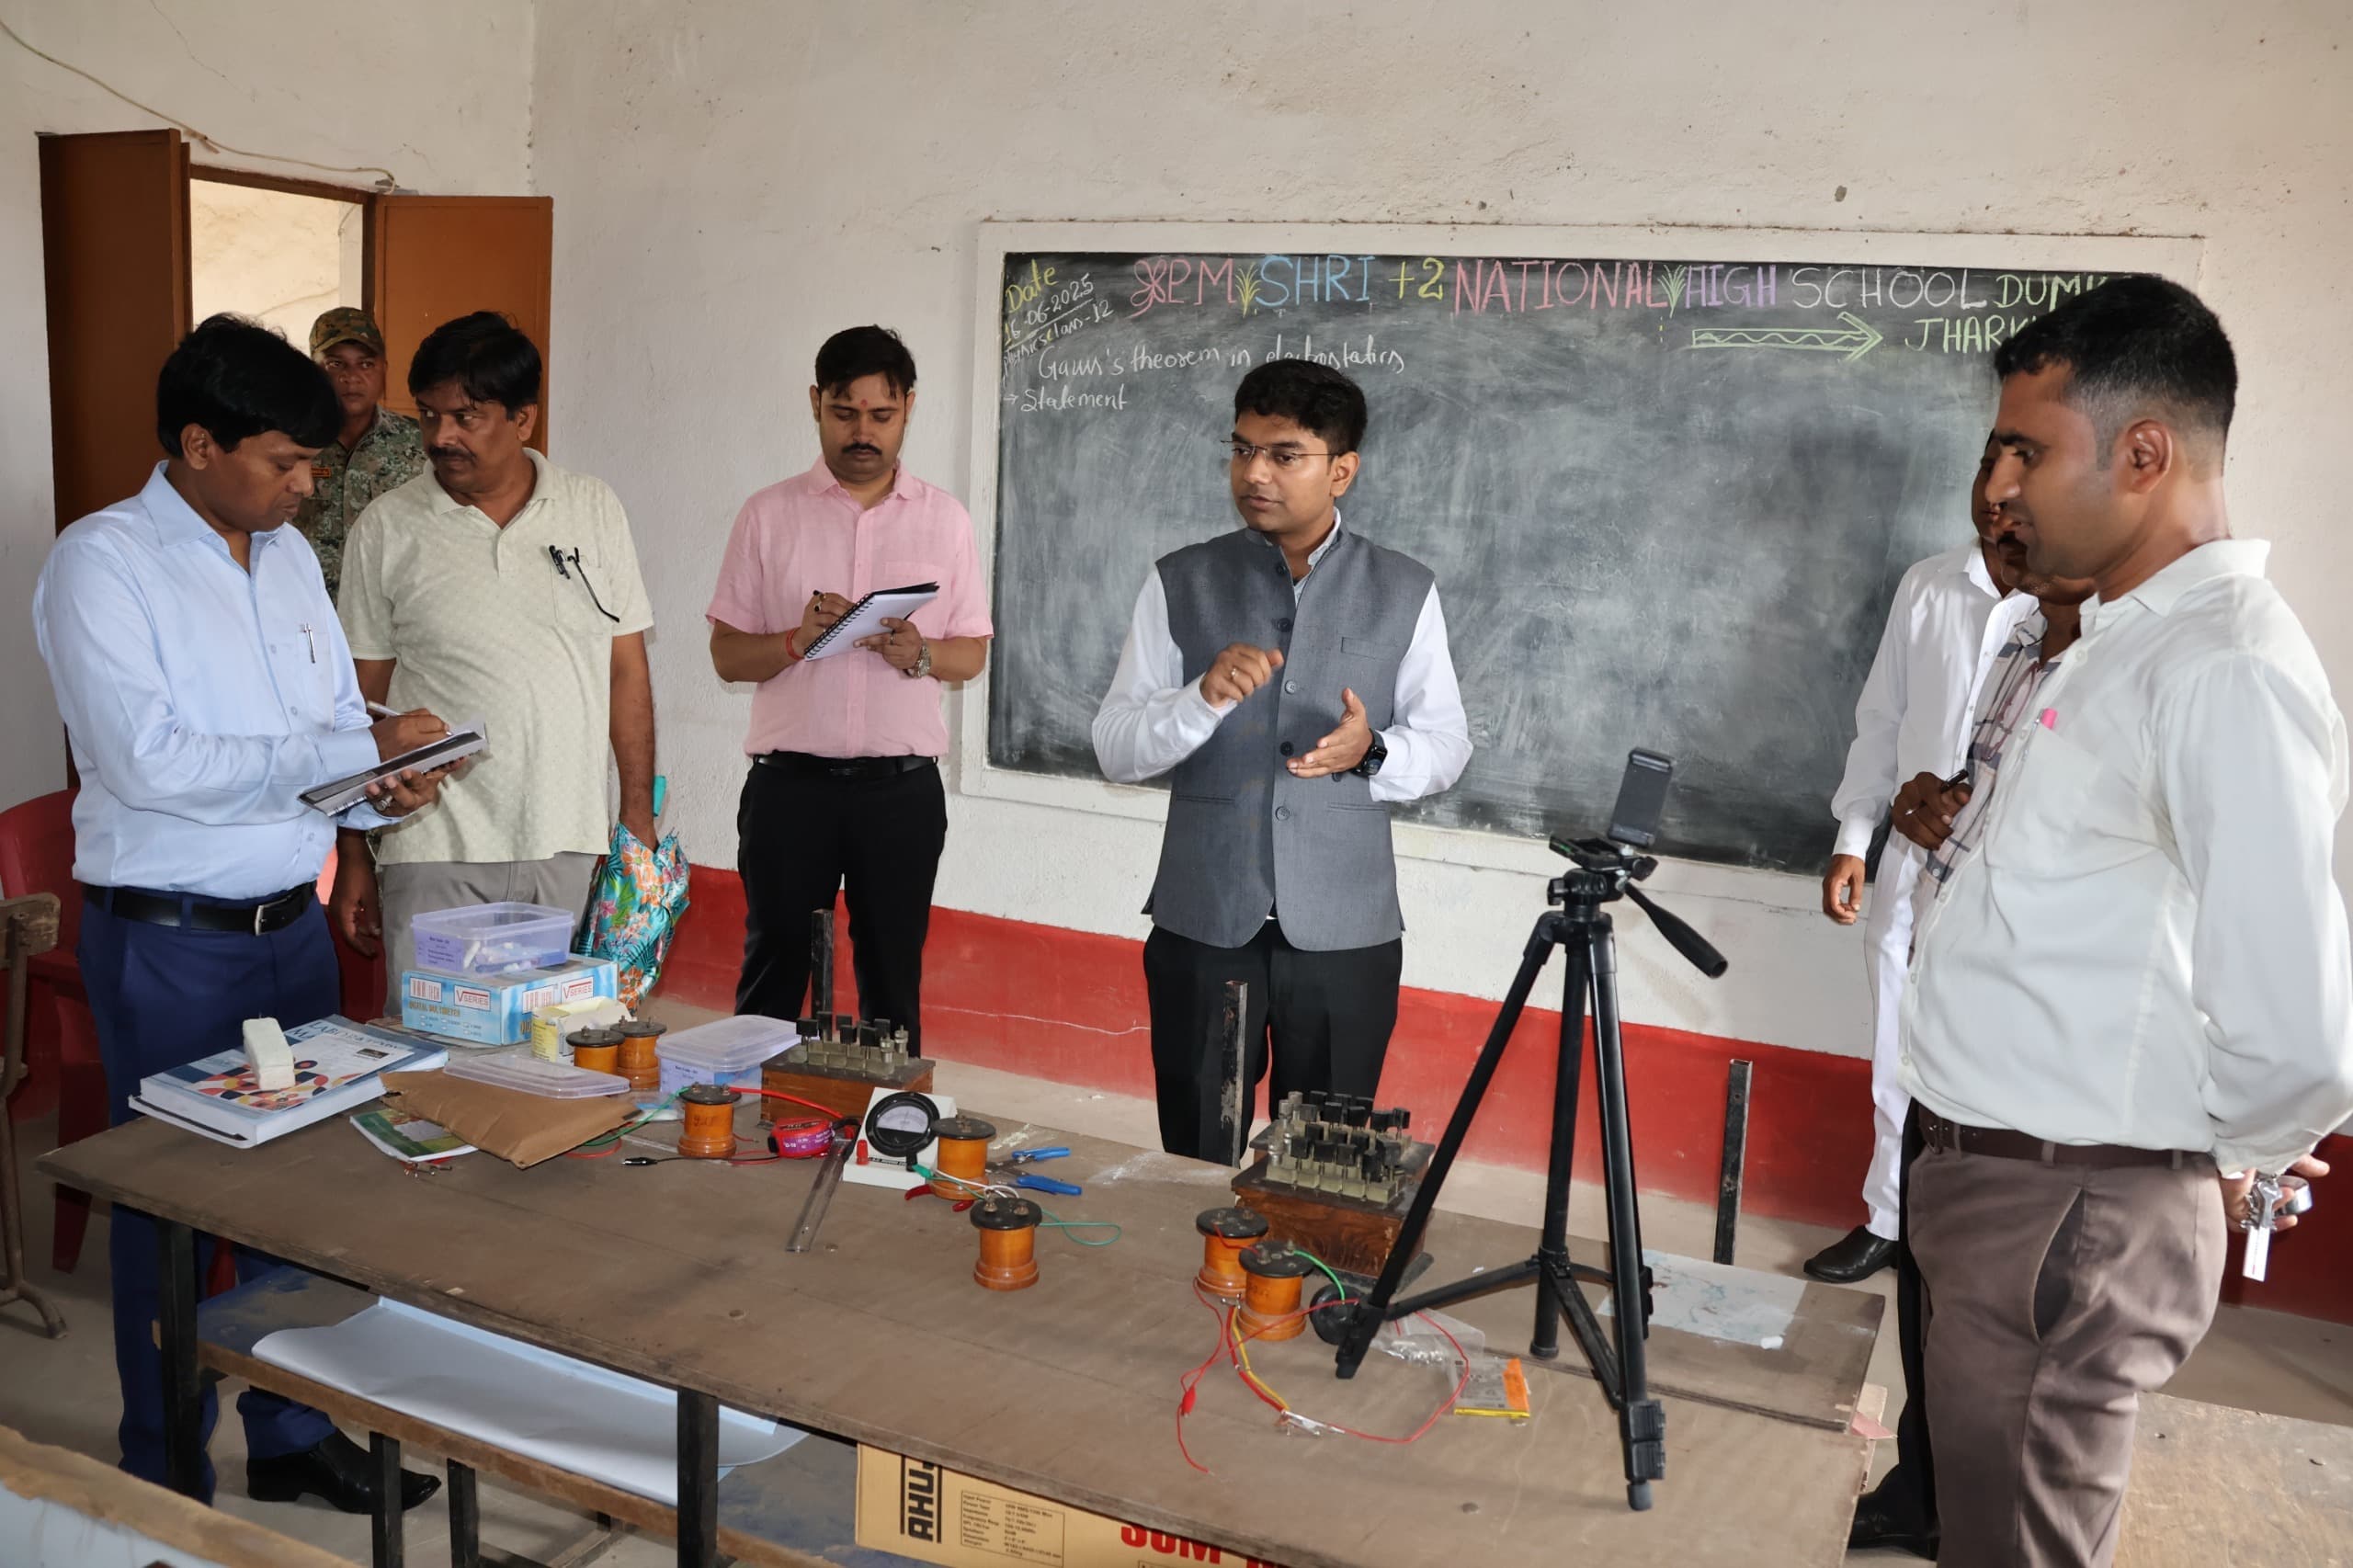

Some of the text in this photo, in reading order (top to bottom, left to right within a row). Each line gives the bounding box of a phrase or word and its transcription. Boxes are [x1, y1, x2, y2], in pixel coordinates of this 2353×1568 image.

[1005, 258, 1059, 313] Date
[1167, 258, 1236, 306] PM
[1255, 255, 1375, 307] SHRI
[1388, 257, 1445, 301] +2
[1455, 259, 1668, 316] NATIONAL
[1685, 264, 1776, 309] HIGH
[1791, 267, 1987, 310] SCHOOL
[1904, 314, 2037, 354] JHARK
[1131, 344, 1221, 373] theorem
[1230, 348, 1252, 368] in
[1020, 382, 1129, 413] Statement
[907, 1461, 935, 1542] AHU
